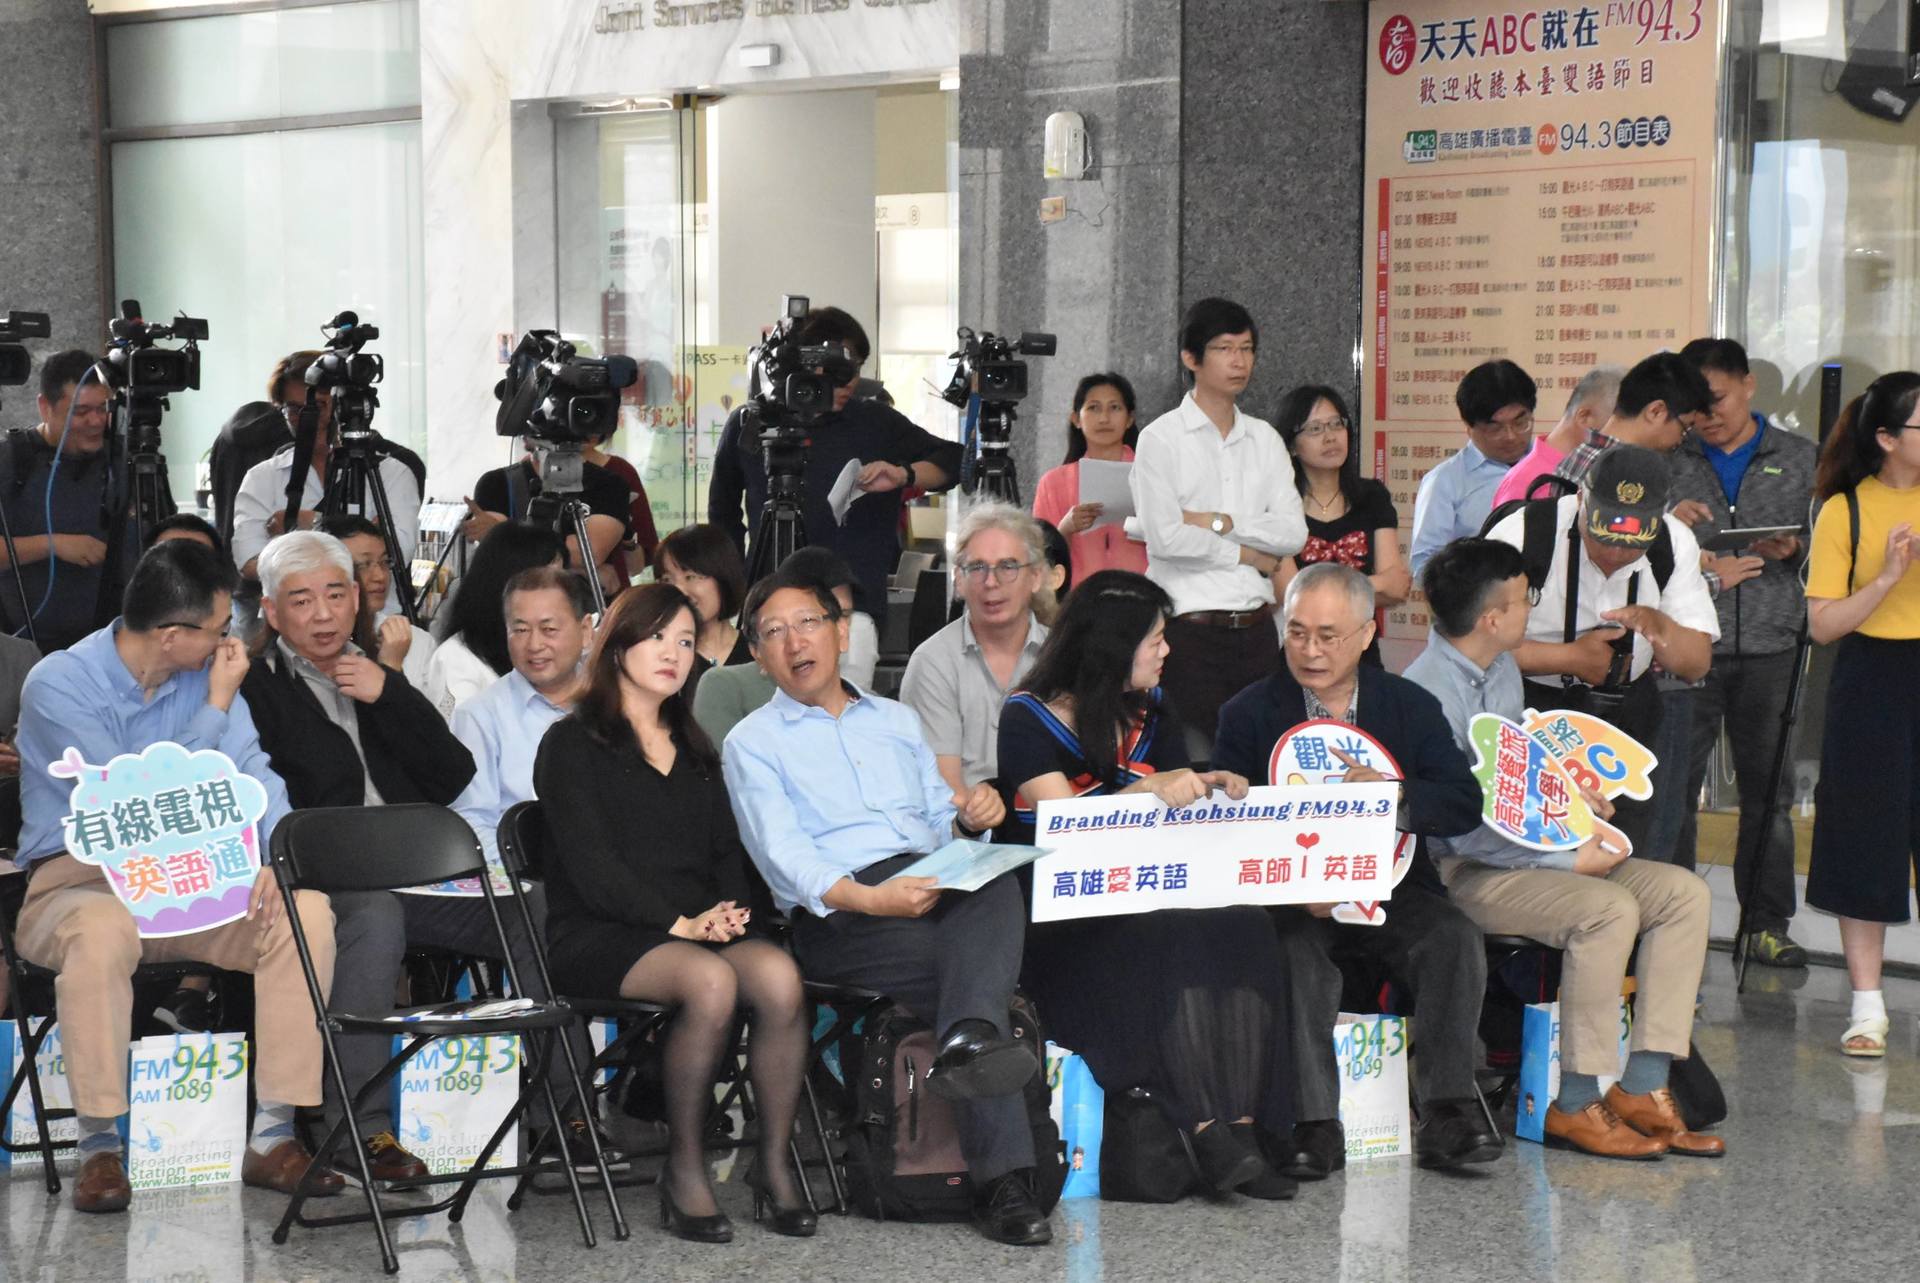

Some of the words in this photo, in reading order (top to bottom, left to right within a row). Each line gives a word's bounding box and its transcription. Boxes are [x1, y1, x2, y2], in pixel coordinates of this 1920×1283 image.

[1560, 121, 1612, 151] 94.3
[1291, 735, 1372, 771] 觀光
[1562, 743, 1627, 793] BC
[67, 779, 244, 856] 有線電視
[1047, 809, 1158, 834] Branding
[1163, 801, 1293, 826] Kaohsiung
[1297, 798, 1393, 819] FM94.3
[1537, 771, 1570, 840] 大學
[121, 836, 252, 902] 英語通
[1053, 863, 1188, 899] 高雄愛英語
[131, 1089, 161, 1104] AM
[165, 1078, 213, 1104] 1089
[400, 1079, 430, 1093] AM
[434, 1069, 484, 1096] 1089
[130, 1150, 232, 1169] Broadcasting
[130, 1165, 186, 1181] Station
[130, 1170, 232, 1189] www.kbs.gov.tw
